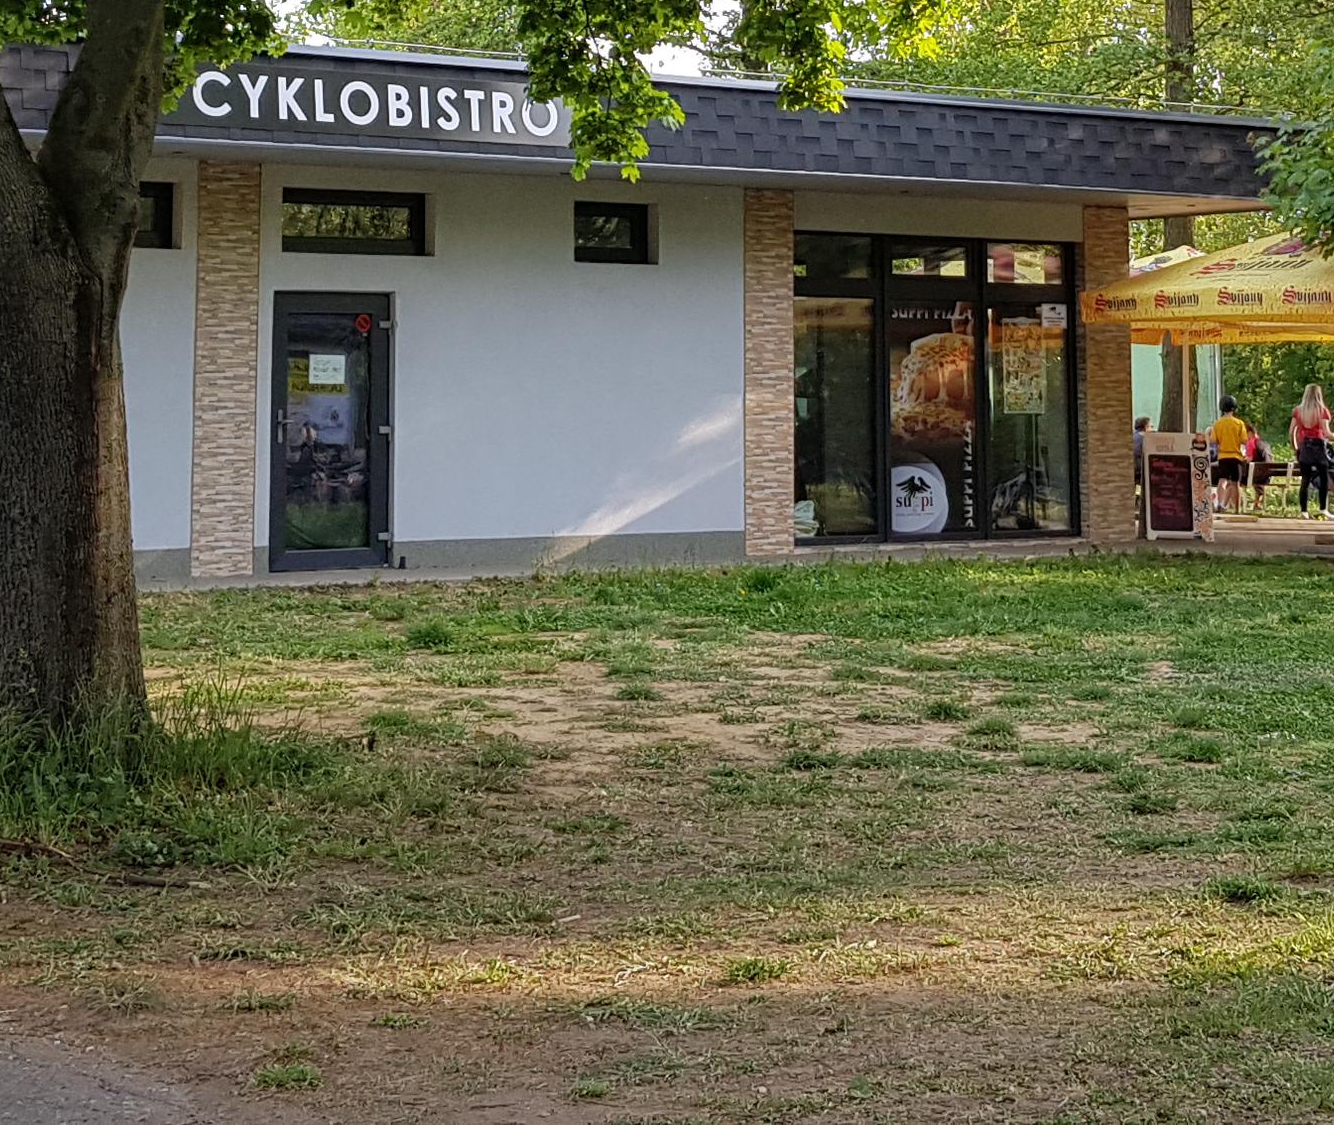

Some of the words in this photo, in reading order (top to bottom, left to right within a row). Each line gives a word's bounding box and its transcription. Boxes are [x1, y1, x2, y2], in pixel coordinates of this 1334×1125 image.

[192, 70, 558, 137] CYKLOBISTRO
[1095, 293, 1137, 312] Svijany
[1154, 289, 1199, 308] Svijany
[1217, 286, 1263, 306] Svijany
[1282, 284, 1332, 305] Svijany
